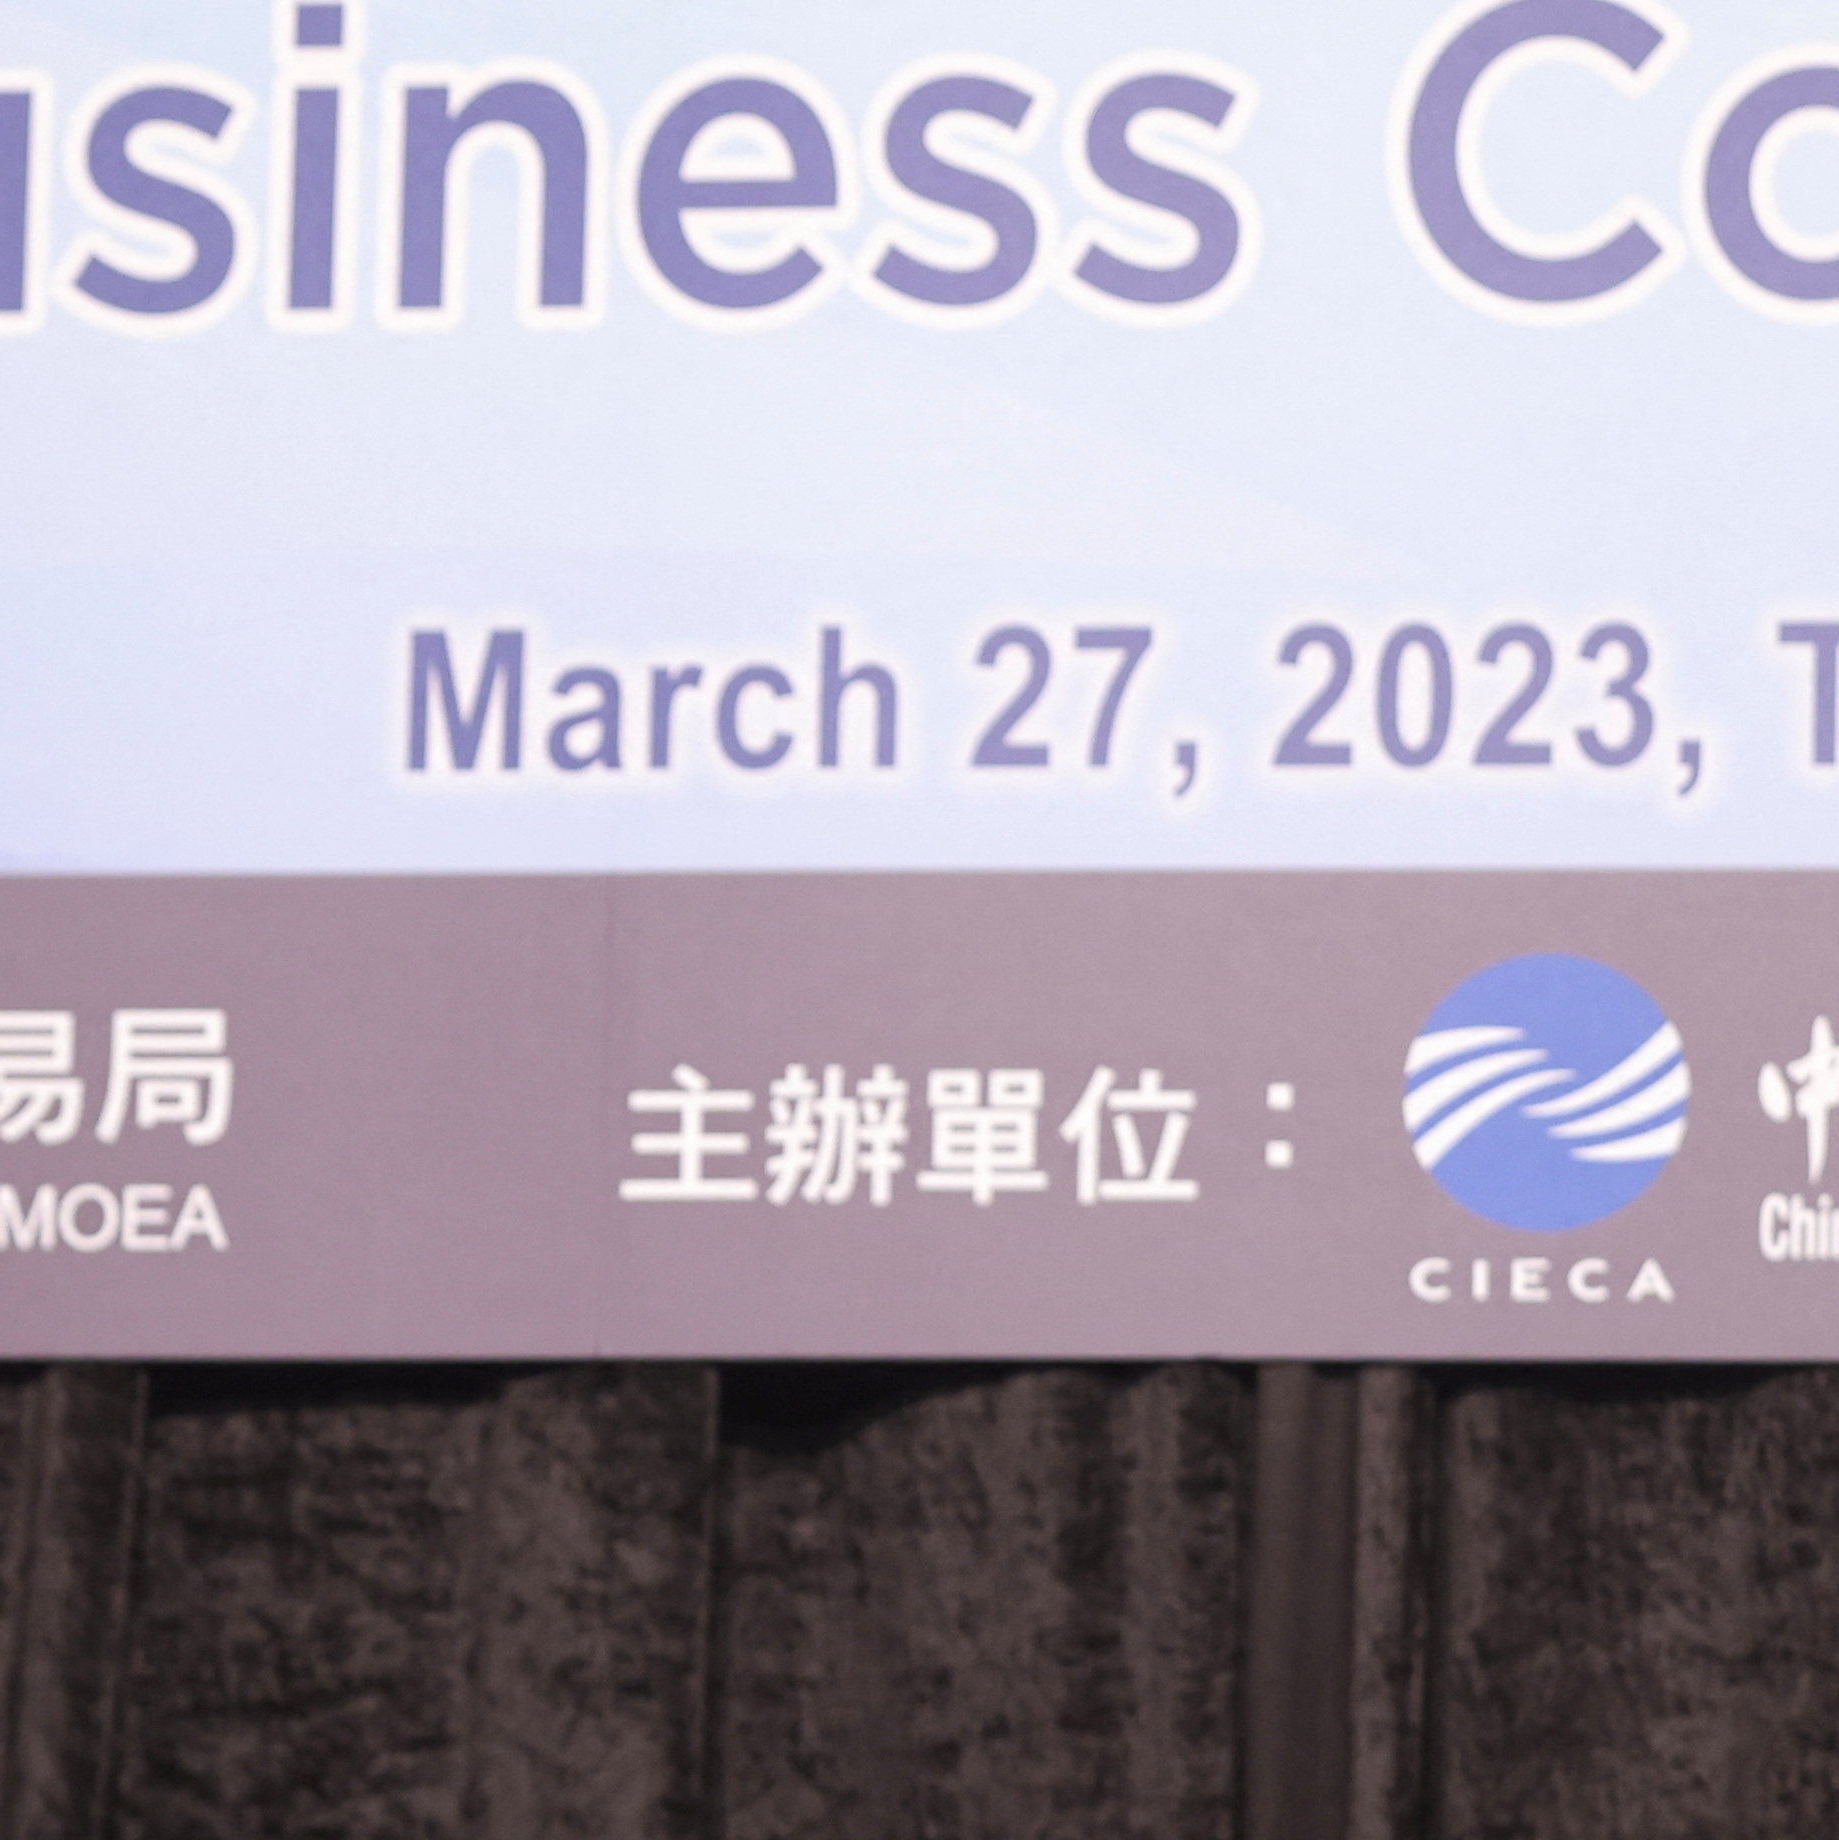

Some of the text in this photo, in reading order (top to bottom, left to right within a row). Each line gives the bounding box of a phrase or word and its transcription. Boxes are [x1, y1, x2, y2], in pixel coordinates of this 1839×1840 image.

[406, 626, 900, 774] March
[970, 625, 1199, 797] 27,
[1272, 622, 1703, 796] 2023,
[1409, 1257, 1676, 1304] CIECA
